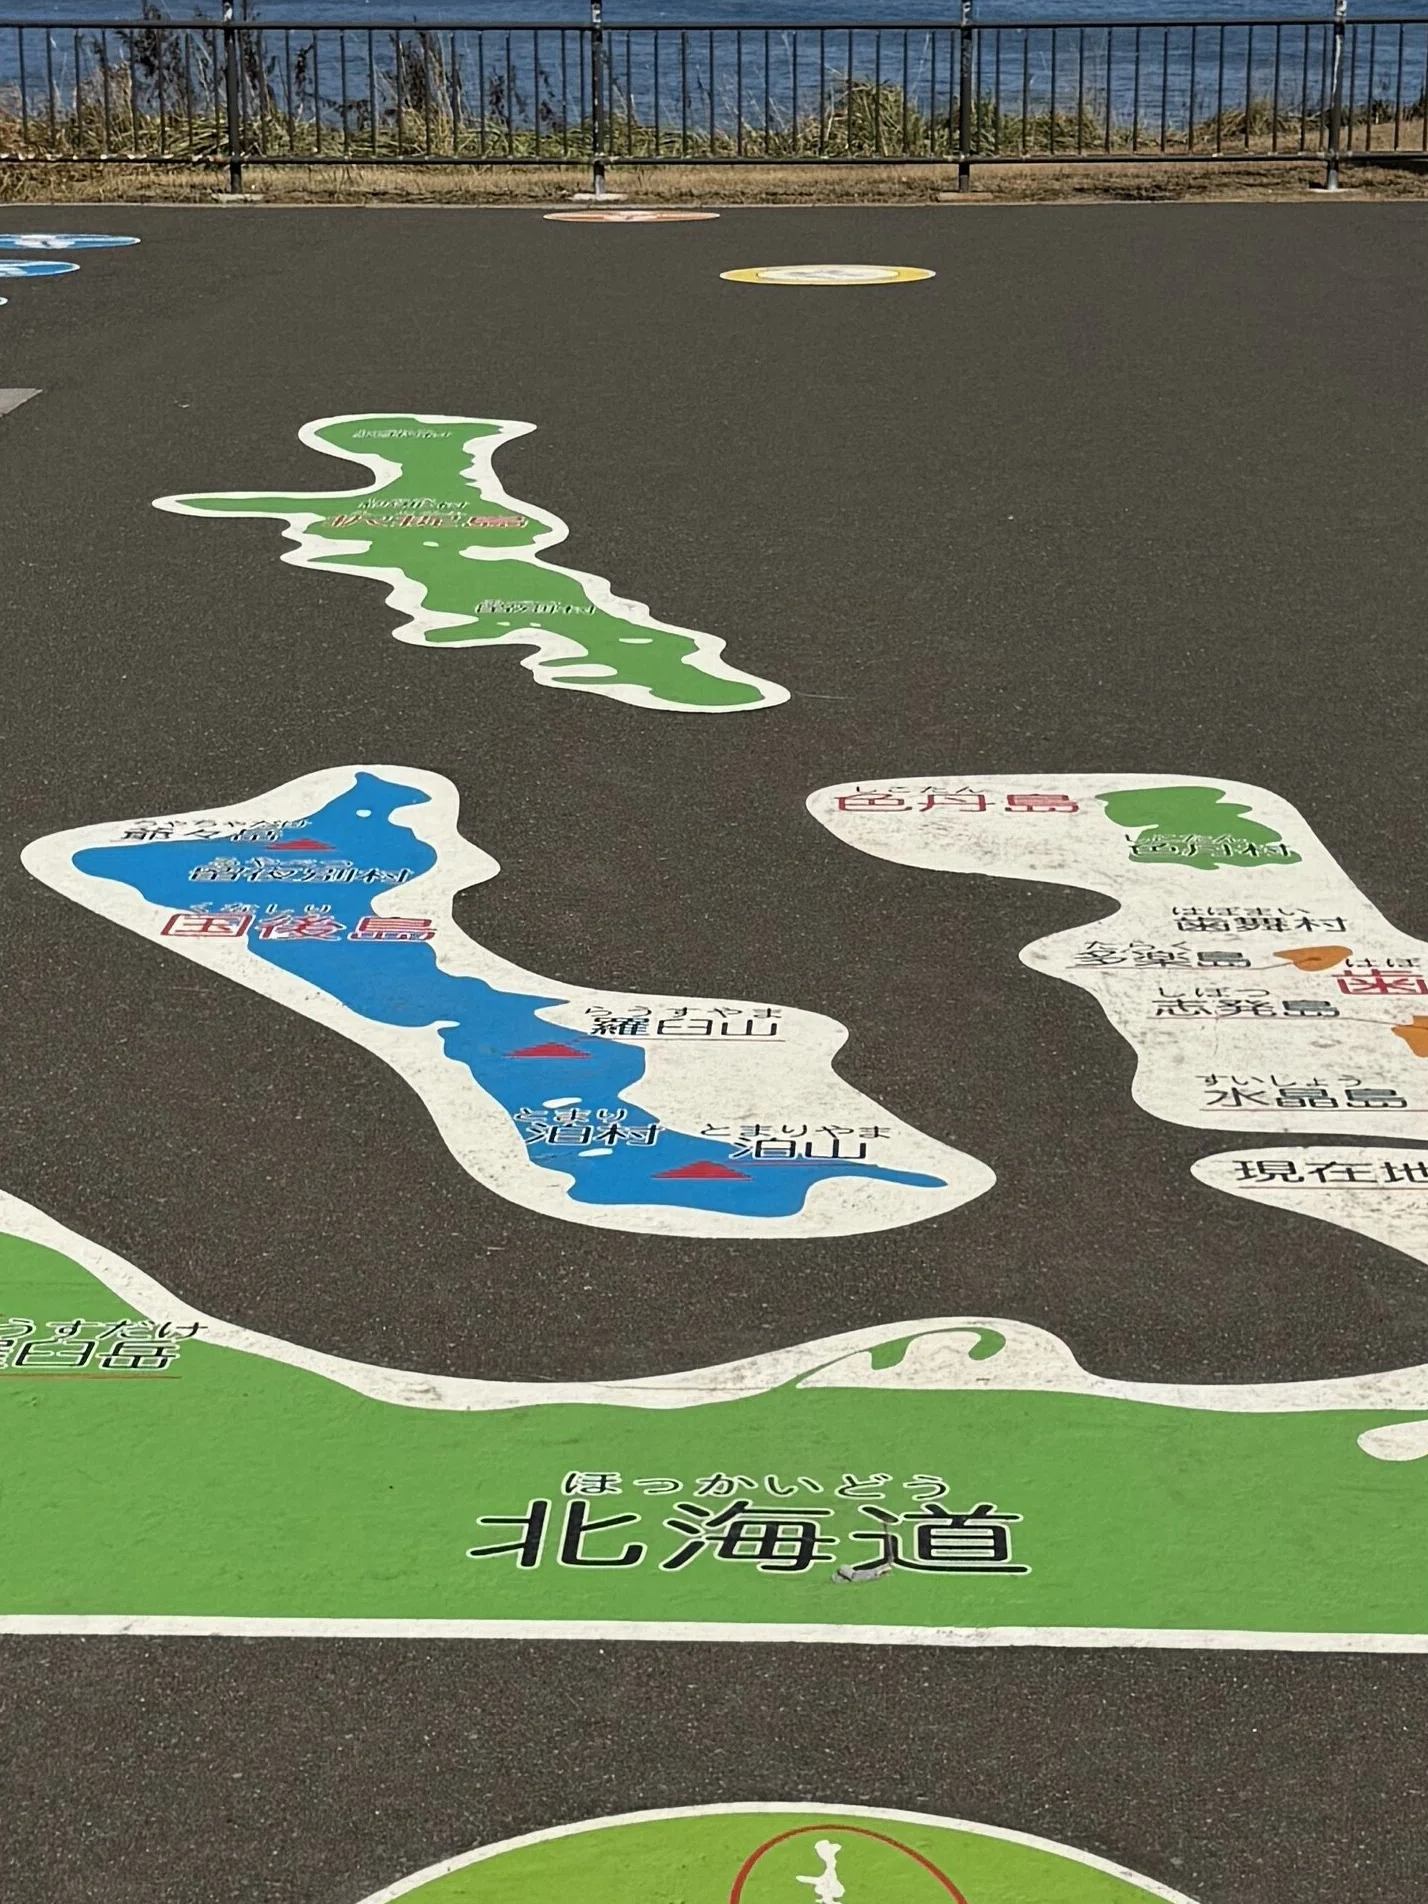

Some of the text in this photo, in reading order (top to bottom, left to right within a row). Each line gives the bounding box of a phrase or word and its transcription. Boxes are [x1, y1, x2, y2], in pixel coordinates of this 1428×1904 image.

[835, 793, 1079, 812] 色丹島
[160, 912, 437, 941] 国後島
[1174, 916, 1347, 933] 歯舞村
[1074, 951, 1251, 967] 多楽島
[584, 1006, 782, 1018] らうすやま
[1152, 999, 1340, 1017] 志発島
[590, 1017, 778, 1037] 羅臼山
[1196, 1073, 1362, 1087] すいしょう
[1204, 1087, 1408, 1108] 水晶島
[513, 1108, 627, 1122] とまり
[525, 1121, 665, 1146] 泊村
[700, 1123, 891, 1139] とまりやま
[728, 1136, 867, 1159] 泊山
[560, 1470, 952, 1501] ほっかいどう
[466, 1498, 1032, 1574] 北海道
